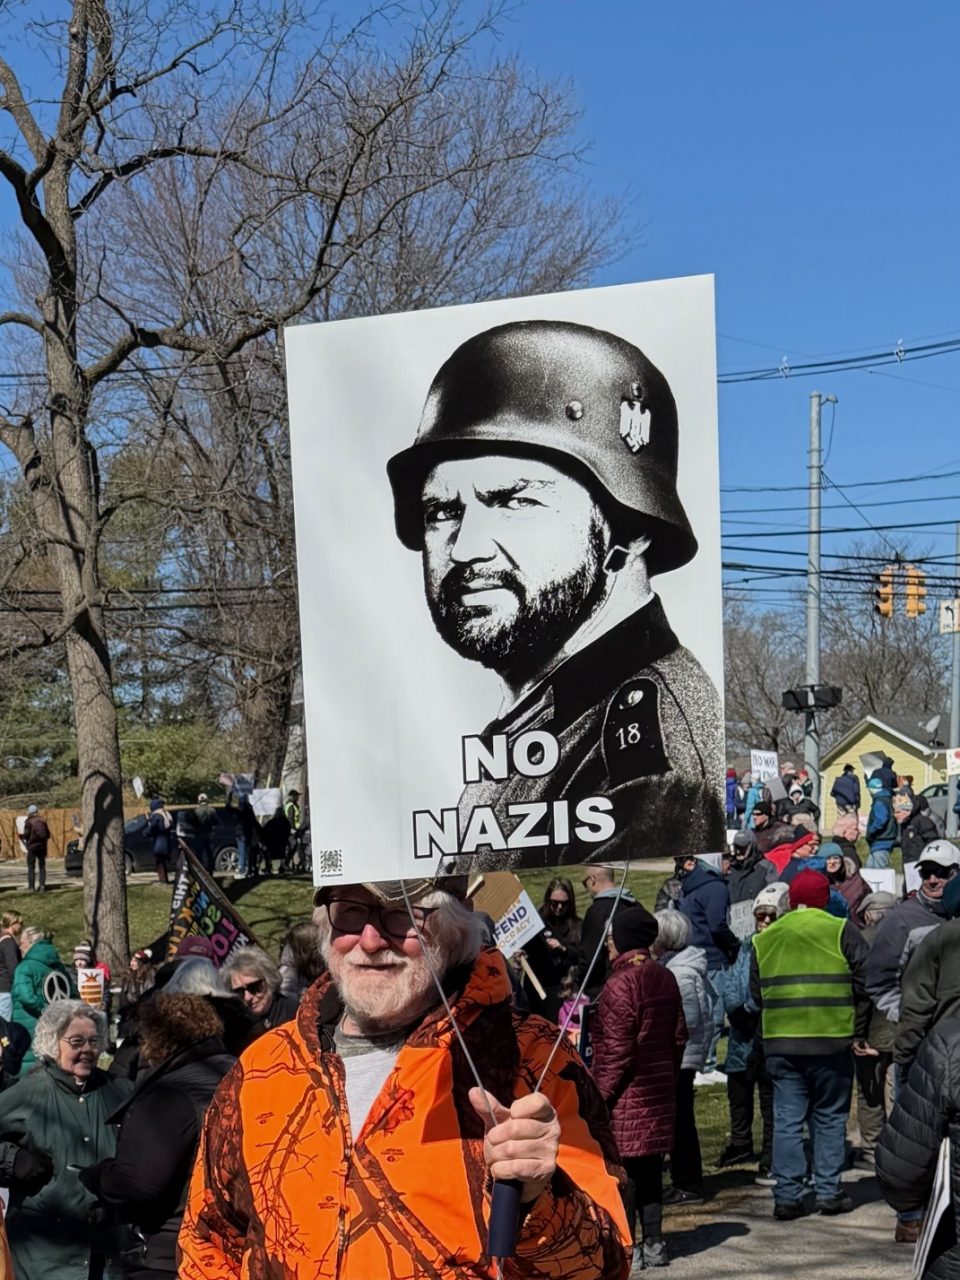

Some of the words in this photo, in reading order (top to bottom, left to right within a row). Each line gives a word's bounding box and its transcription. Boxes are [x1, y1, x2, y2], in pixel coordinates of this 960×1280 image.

[462, 730, 560, 784] NO
[615, 722, 641, 750] 18
[413, 796, 616, 859] NAZIS
